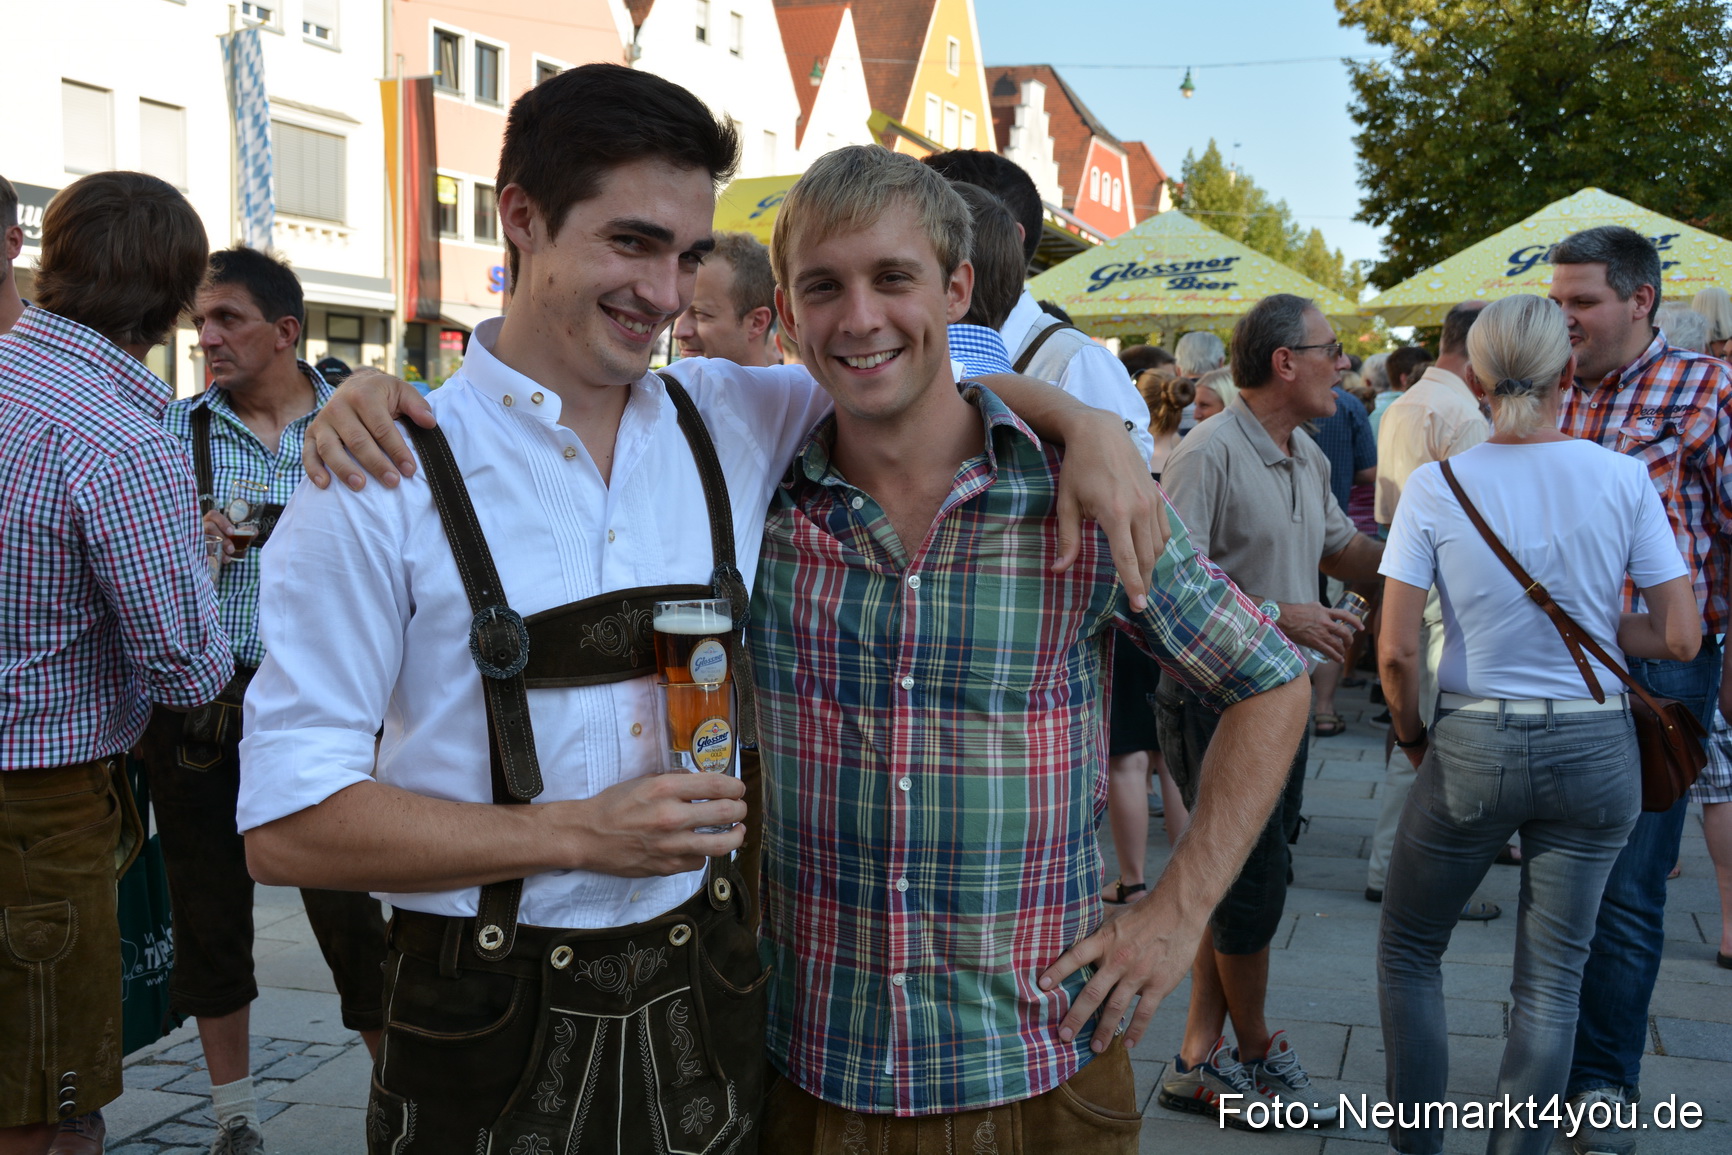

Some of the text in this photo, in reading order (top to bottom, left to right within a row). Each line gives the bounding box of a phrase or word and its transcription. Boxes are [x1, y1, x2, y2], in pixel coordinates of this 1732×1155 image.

[1086, 256, 1241, 293] Glossner
[1166, 275, 1239, 291] Bier
[694, 653, 724, 672] Glossner
[697, 731, 729, 754] Glossner
